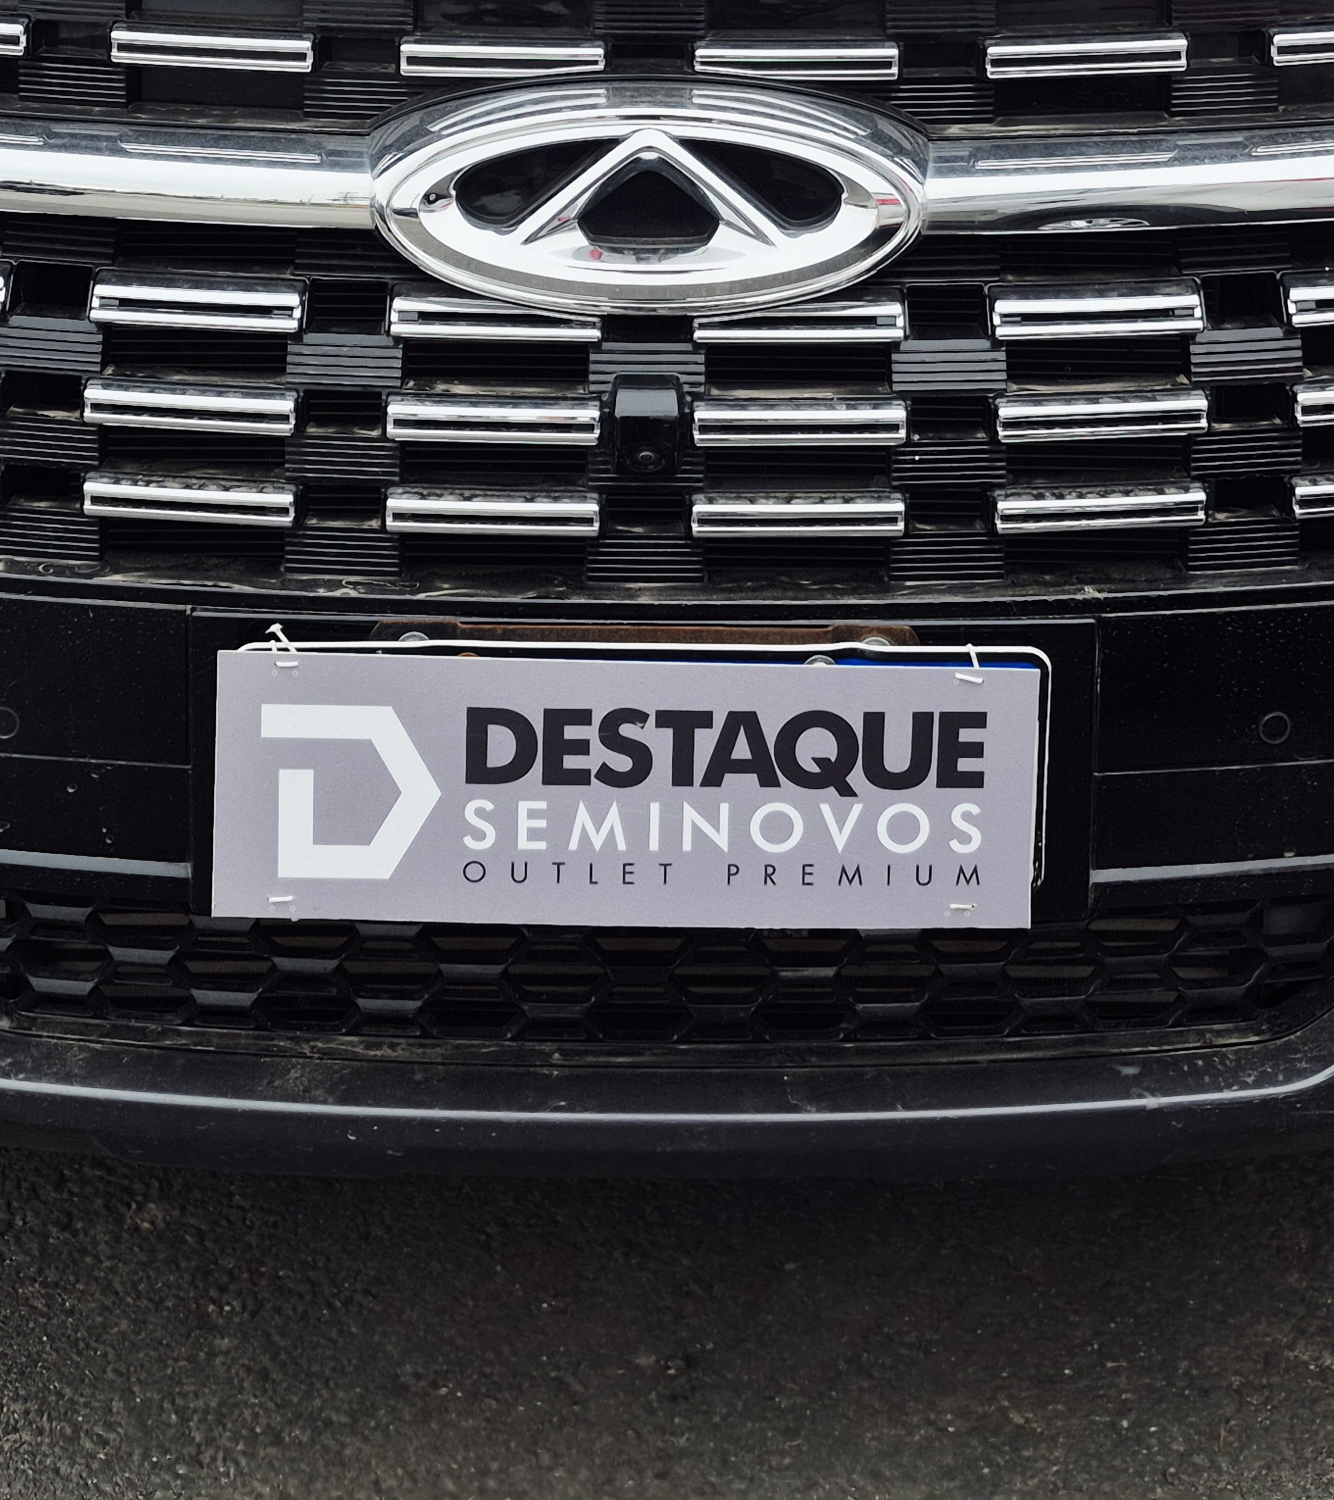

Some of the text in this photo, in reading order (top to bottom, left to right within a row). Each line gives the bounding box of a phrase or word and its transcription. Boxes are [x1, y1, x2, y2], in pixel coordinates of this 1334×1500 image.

[465, 706, 988, 798] DESTAQUE
[462, 799, 984, 855] SEMINOVOS
[461, 860, 983, 887] OUTLET PREMIUM
